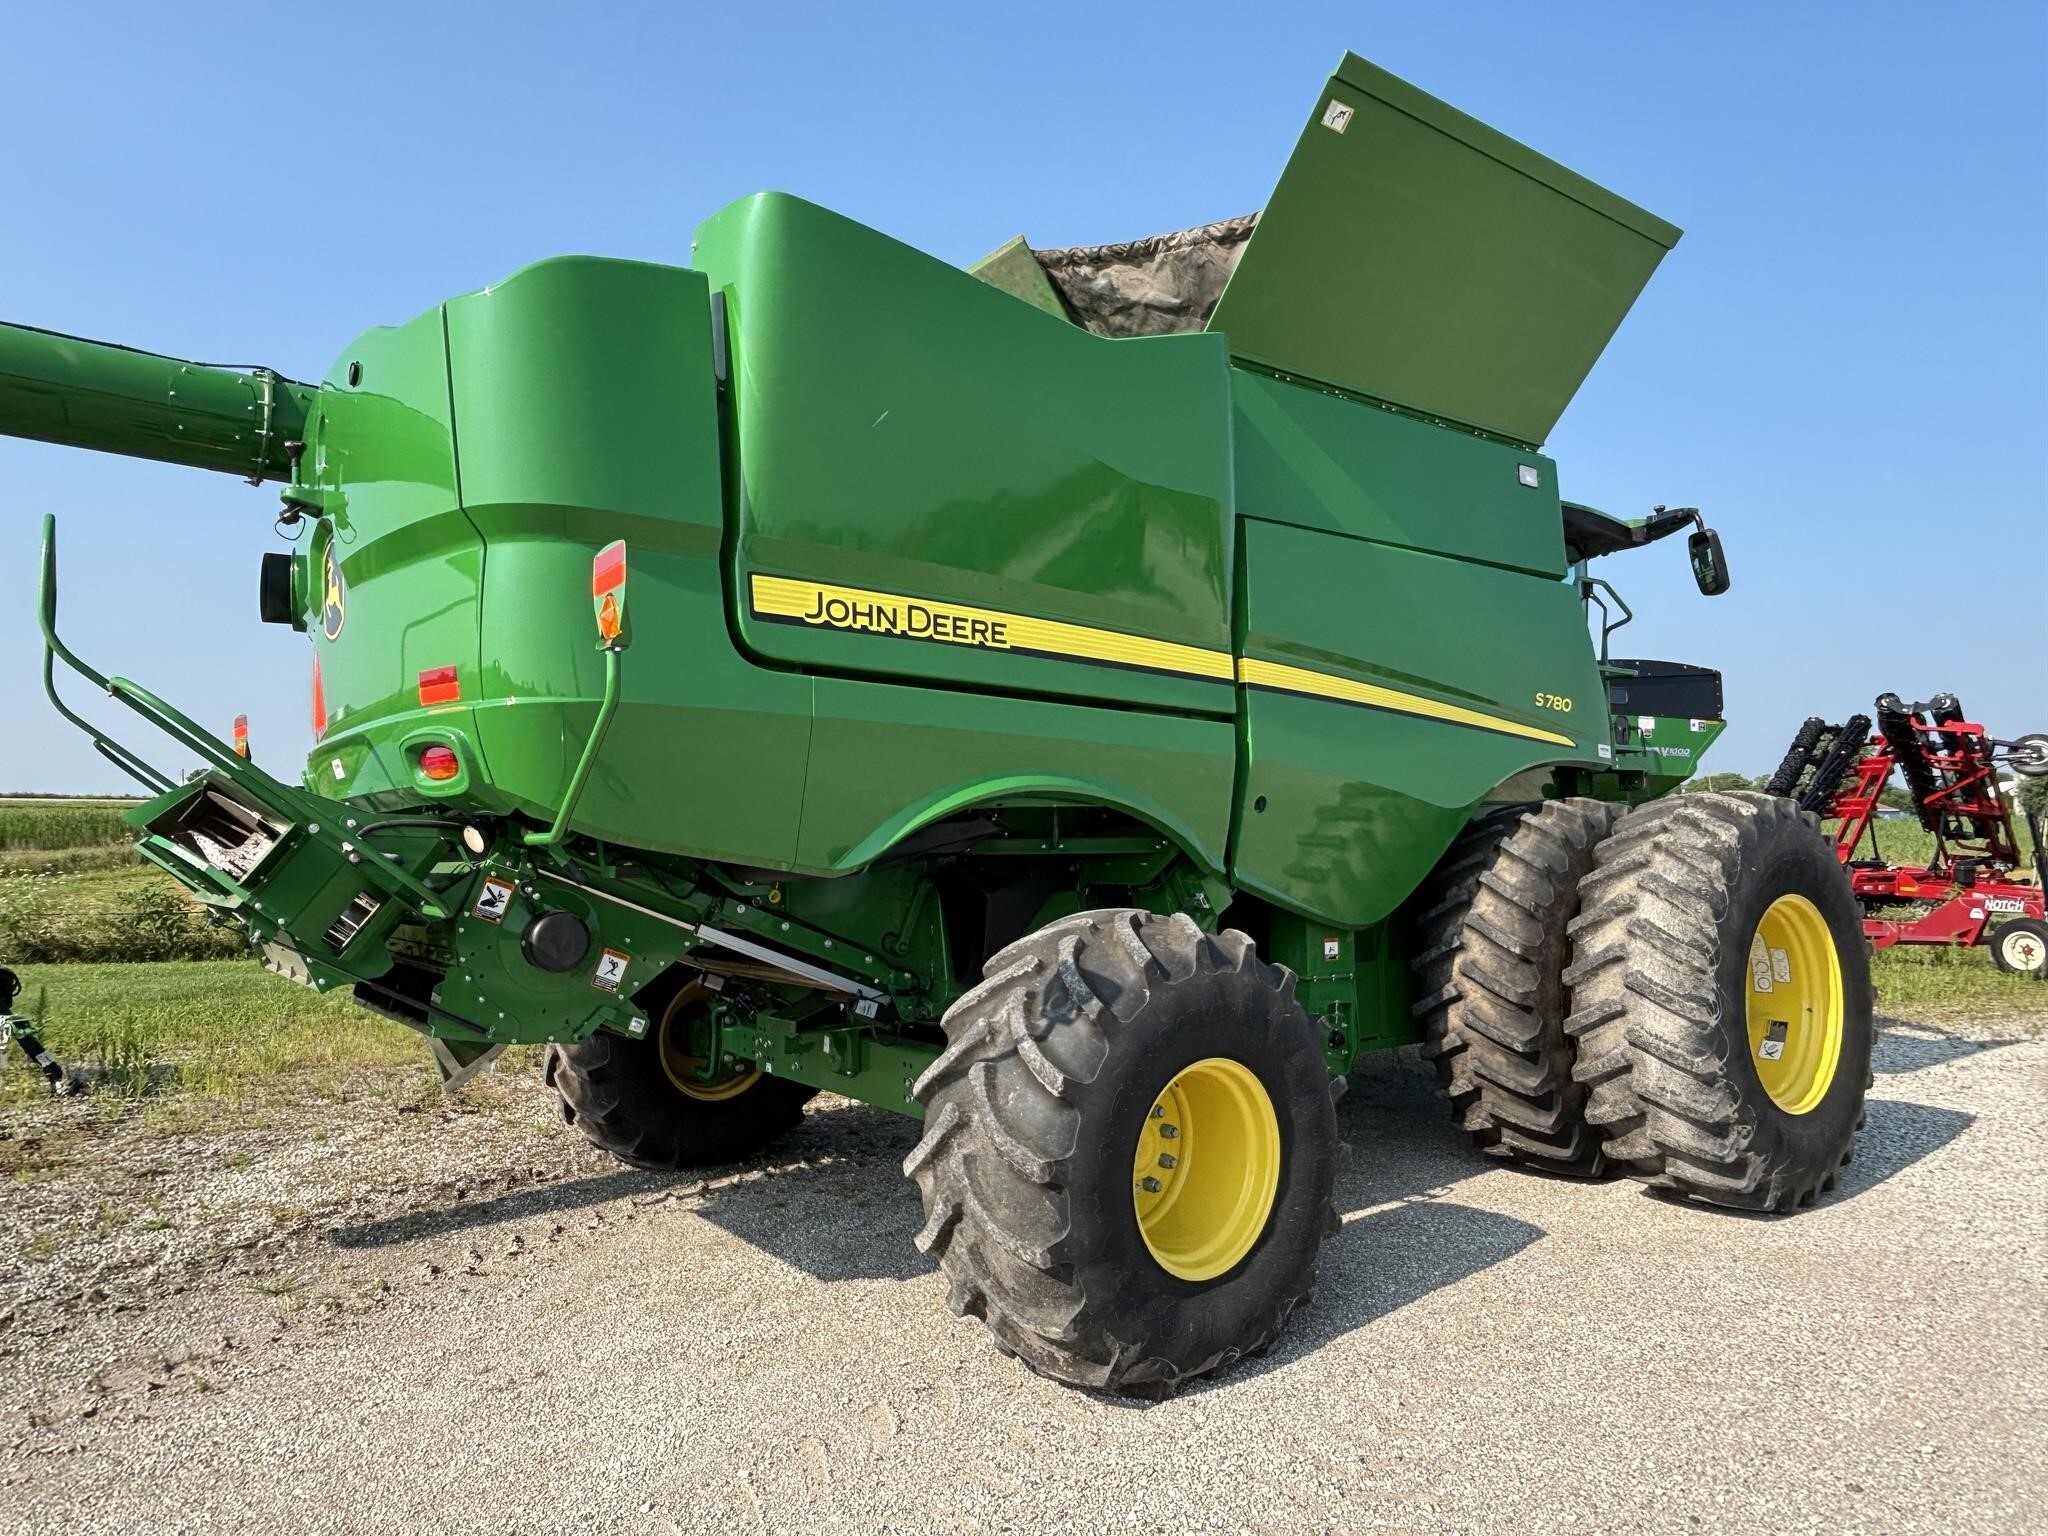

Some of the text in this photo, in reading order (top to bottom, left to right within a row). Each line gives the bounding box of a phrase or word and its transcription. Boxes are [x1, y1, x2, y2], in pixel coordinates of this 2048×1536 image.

[804, 592, 1008, 644] JOHN DEERE
[1535, 692, 1572, 712] S780
[1984, 899, 2024, 912] NOTCH
